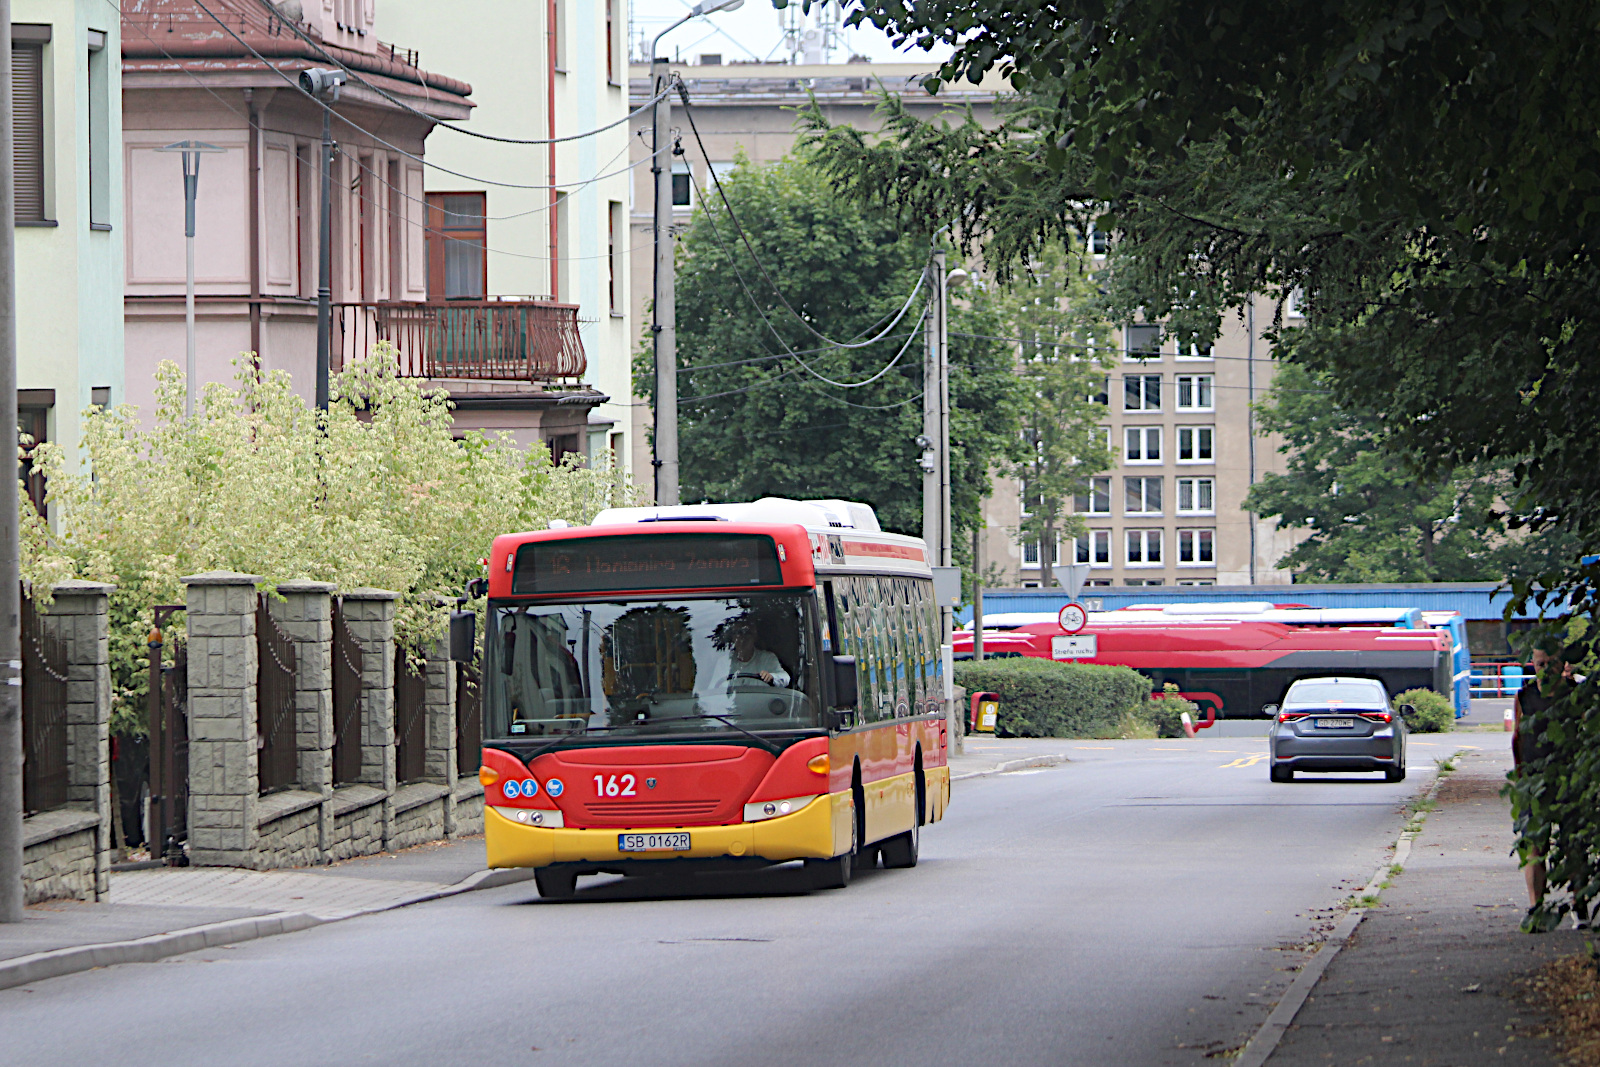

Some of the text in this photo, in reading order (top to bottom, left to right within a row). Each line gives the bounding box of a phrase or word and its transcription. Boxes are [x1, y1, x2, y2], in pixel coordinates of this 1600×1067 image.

[1086, 600, 1101, 610] 17
[593, 774, 637, 797] 162
[626, 834, 688, 848] SB 0162R
